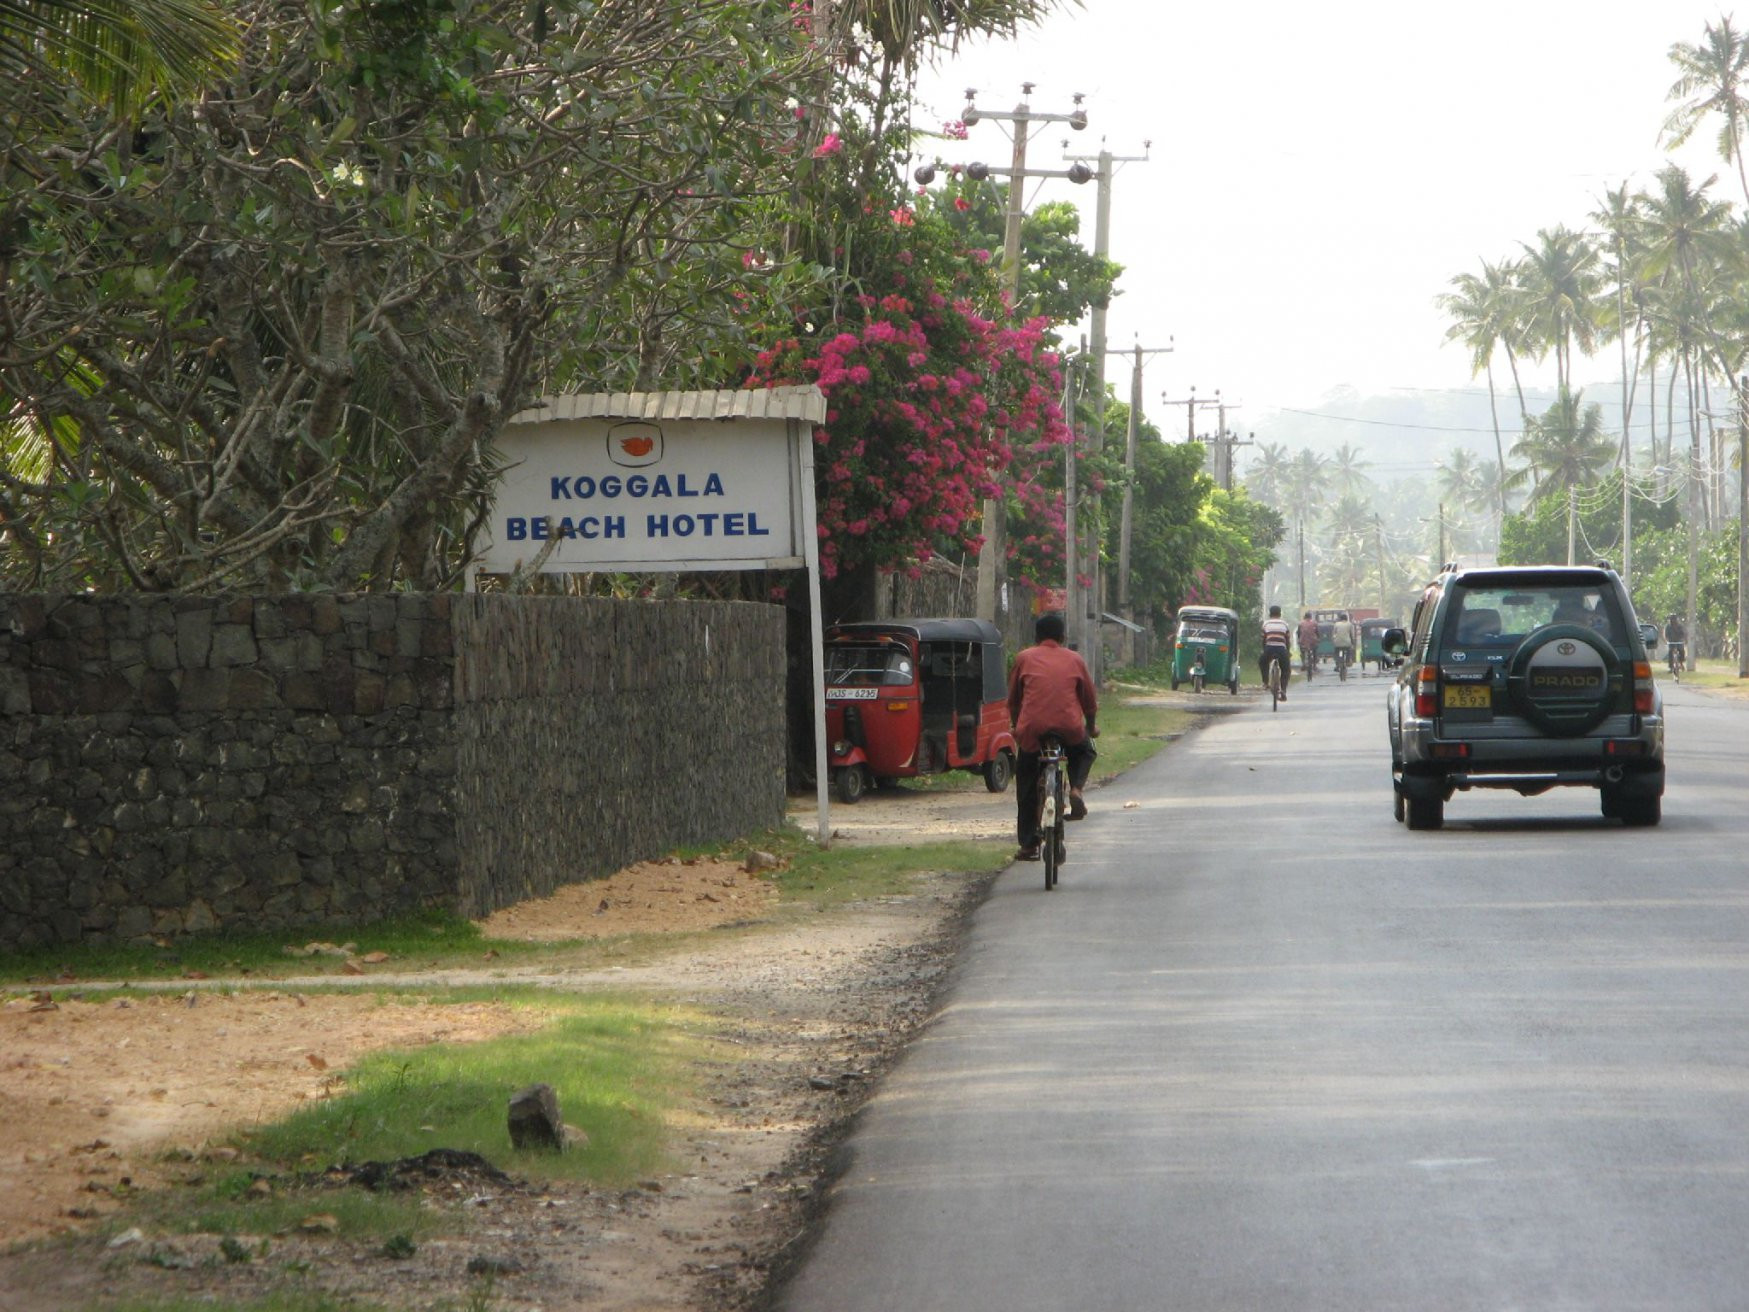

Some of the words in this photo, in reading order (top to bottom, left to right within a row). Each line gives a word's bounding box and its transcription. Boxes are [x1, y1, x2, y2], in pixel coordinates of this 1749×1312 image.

[550, 473, 725, 500] KOGGALA
[506, 516, 626, 541] BEACH
[647, 513, 769, 537] HOTEL
[1533, 675, 1601, 686] PRADO
